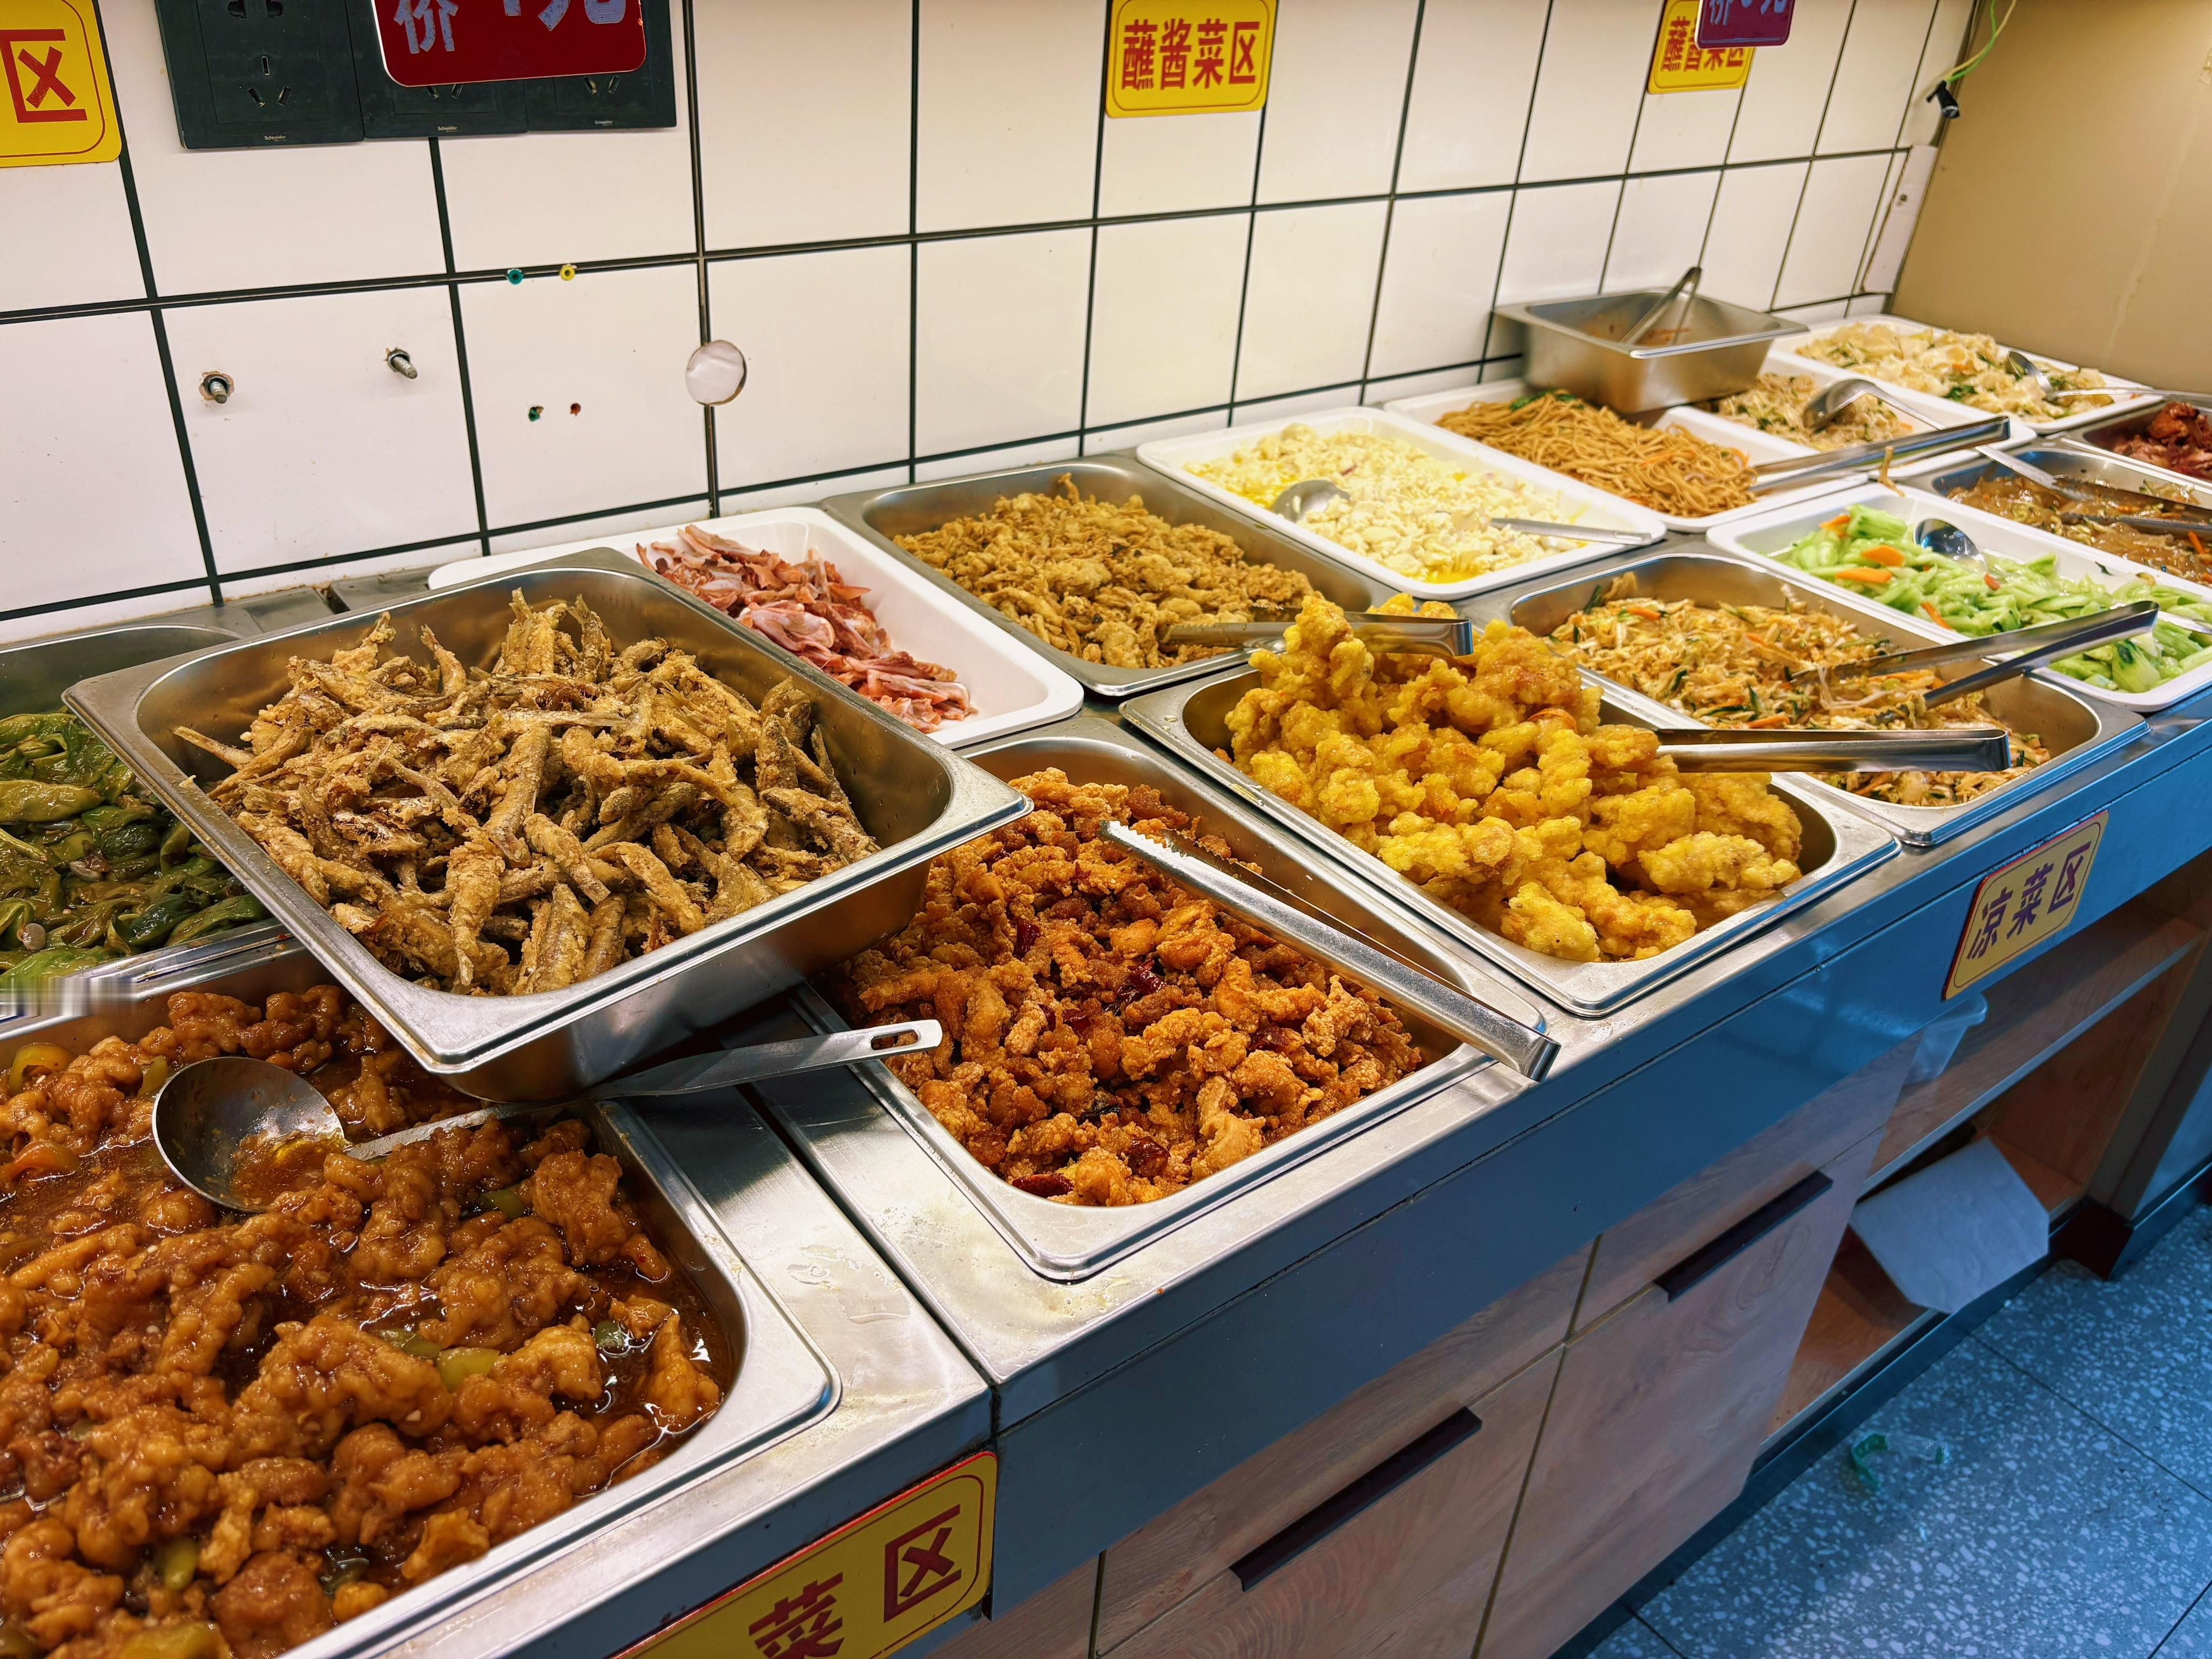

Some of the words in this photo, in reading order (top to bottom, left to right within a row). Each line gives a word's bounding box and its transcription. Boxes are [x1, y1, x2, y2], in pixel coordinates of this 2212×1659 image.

[0, 29, 88, 123] 区
[1122, 18, 1260, 91] 蘸酱菜区
[1966, 840, 2092, 960] 凉菜区
